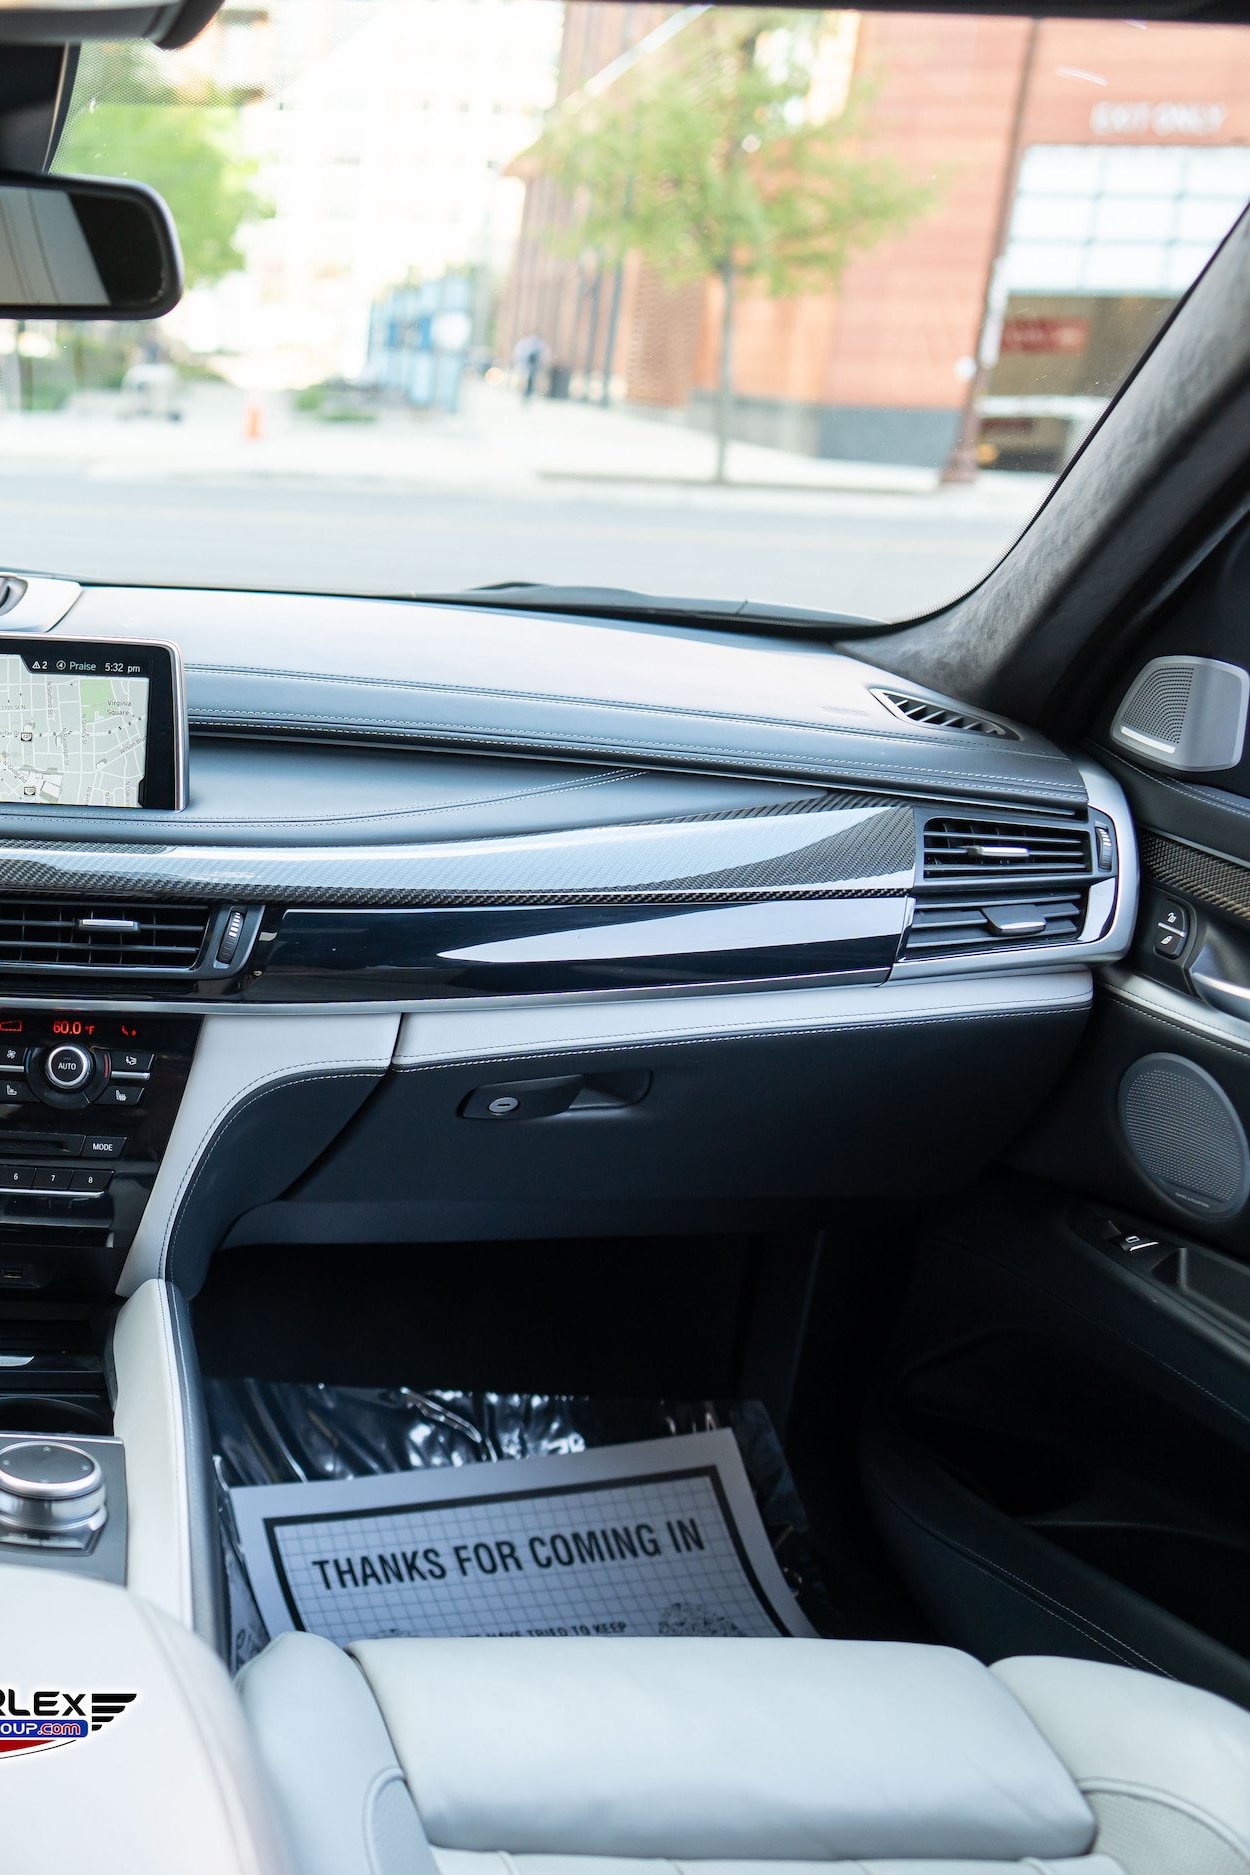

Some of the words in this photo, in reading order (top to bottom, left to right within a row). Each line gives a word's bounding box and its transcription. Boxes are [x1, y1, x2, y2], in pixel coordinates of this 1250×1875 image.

[42, 661, 47, 670] 2
[69, 662, 97, 671] Praise
[105, 662, 124, 672] 5:32
[127, 665, 141, 673] pm
[107, 709, 130, 717] Square
[53, 1020, 82, 1035] 60.0
[57, 1062, 77, 1071] AUTO
[92, 1142, 113, 1152] MODE
[13, 1172, 19, 1180] 6
[51, 1174, 56, 1182] 7
[88, 1176, 93, 1184] 8
[312, 1548, 448, 1591] THANKS
[454, 1540, 524, 1578] FOR
[527, 1523, 662, 1570] COMING
[665, 1517, 706, 1555] IN
[570, 1625, 591, 1636] TO
[592, 1621, 627, 1634] KEEP
